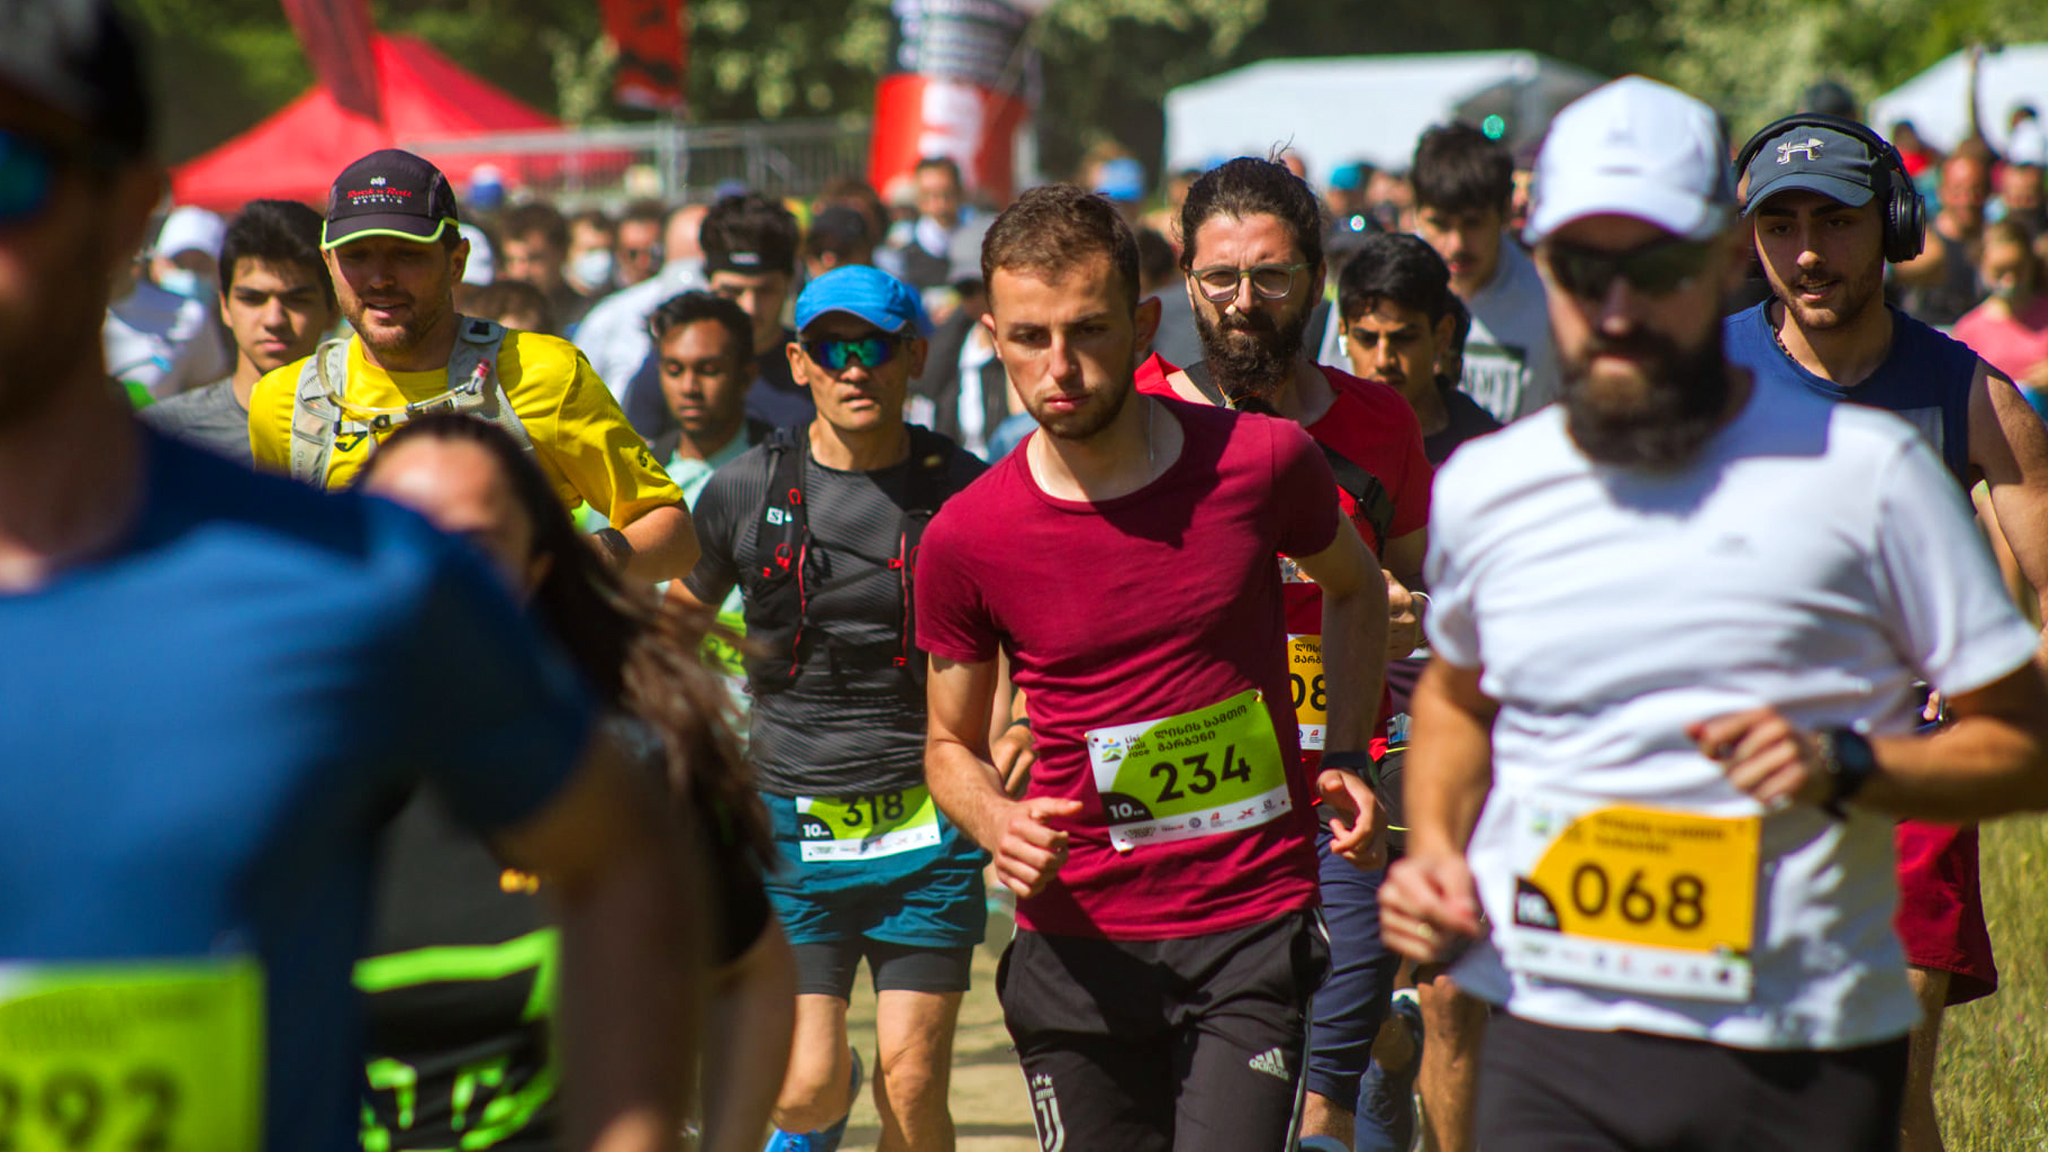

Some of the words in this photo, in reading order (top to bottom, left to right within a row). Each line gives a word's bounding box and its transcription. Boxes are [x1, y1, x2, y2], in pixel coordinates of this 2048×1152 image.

[1290, 673, 1327, 711] 08
[1150, 744, 1251, 803] 234
[840, 792, 905, 827] 318
[1571, 862, 1706, 931] 068
[1249, 1058, 1289, 1081] adidas
